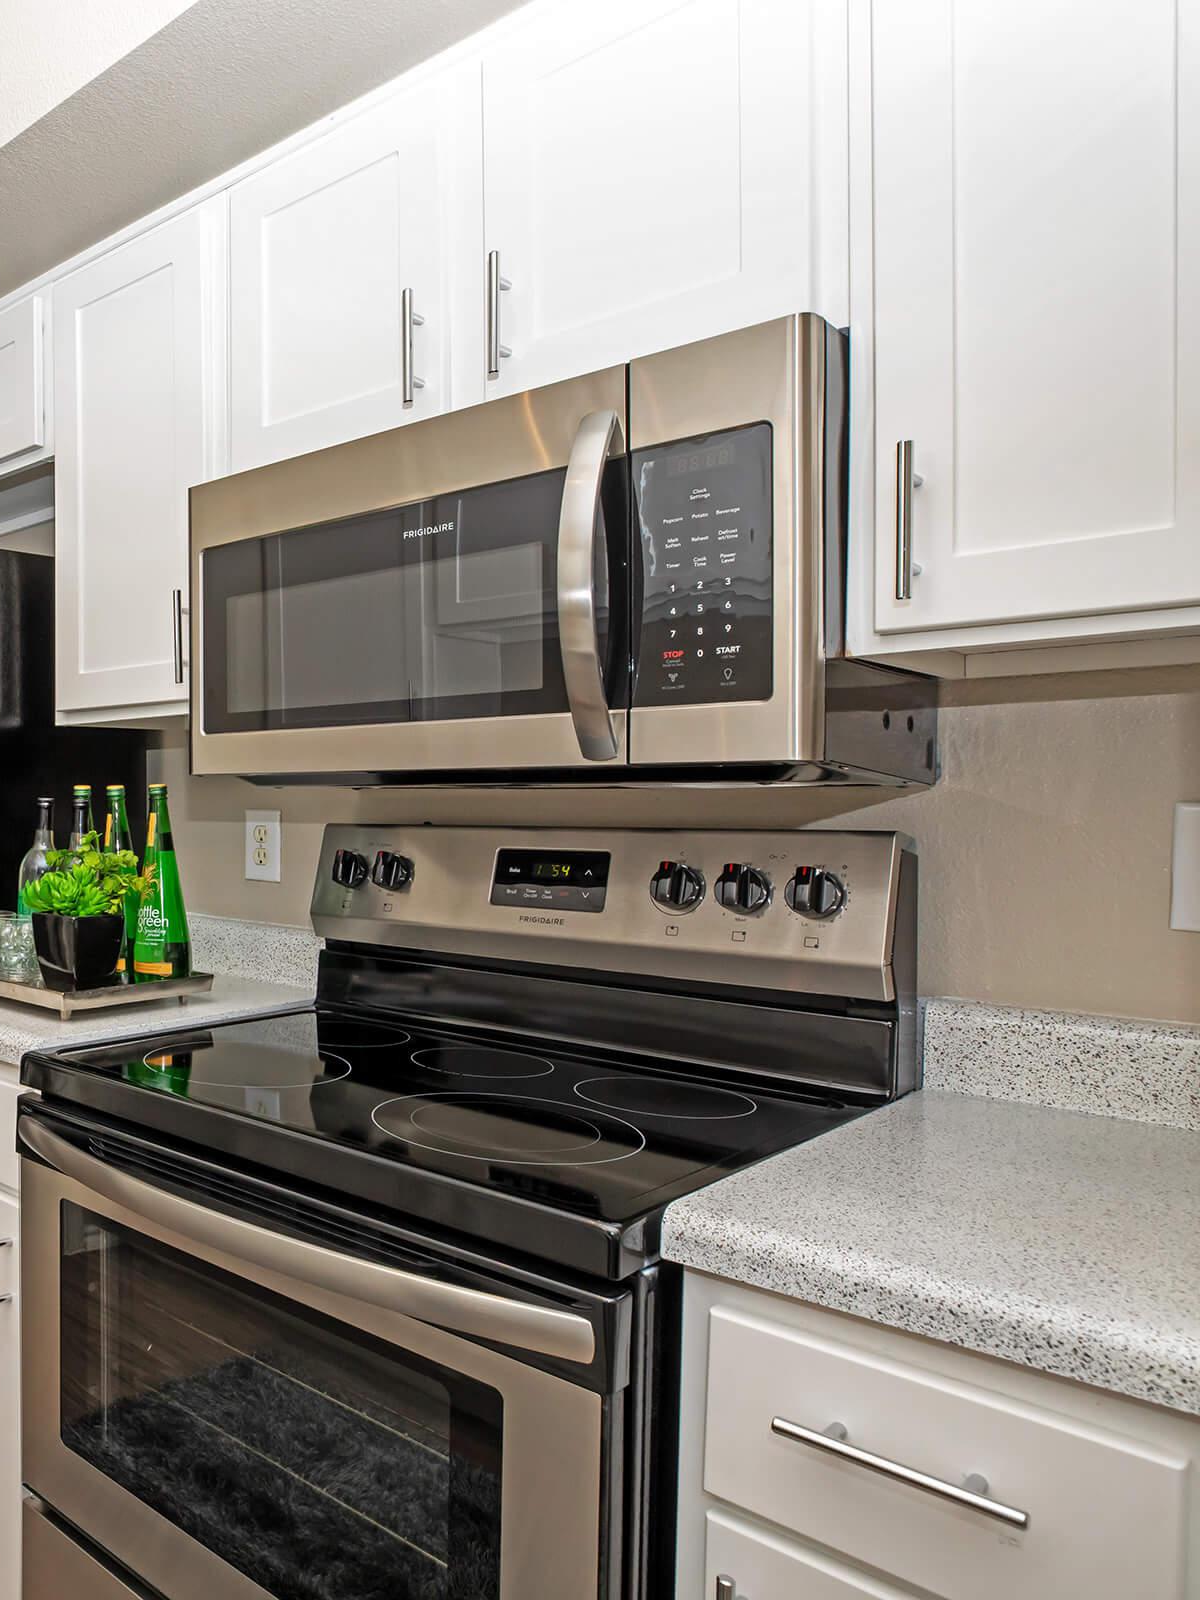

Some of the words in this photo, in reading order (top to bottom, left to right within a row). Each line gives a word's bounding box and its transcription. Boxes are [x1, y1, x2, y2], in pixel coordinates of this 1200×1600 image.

[403, 522, 454, 540] FRIGIDAIRE
[696, 580, 704, 589] 2
[725, 577, 732, 586] 3
[670, 584, 675, 593] 1
[697, 604, 704, 613] 5
[725, 601, 732, 609] 6
[697, 627, 704, 636] 8
[725, 624, 732, 633] 9
[670, 630, 676, 638] 7
[663, 650, 684, 659] STOP
[697, 649, 704, 658] 0
[716, 645, 741, 655] START
[137, 905, 160, 918] ottle
[519, 915, 566, 926] FRIGIDAIRE
[137, 918, 169, 933] green
